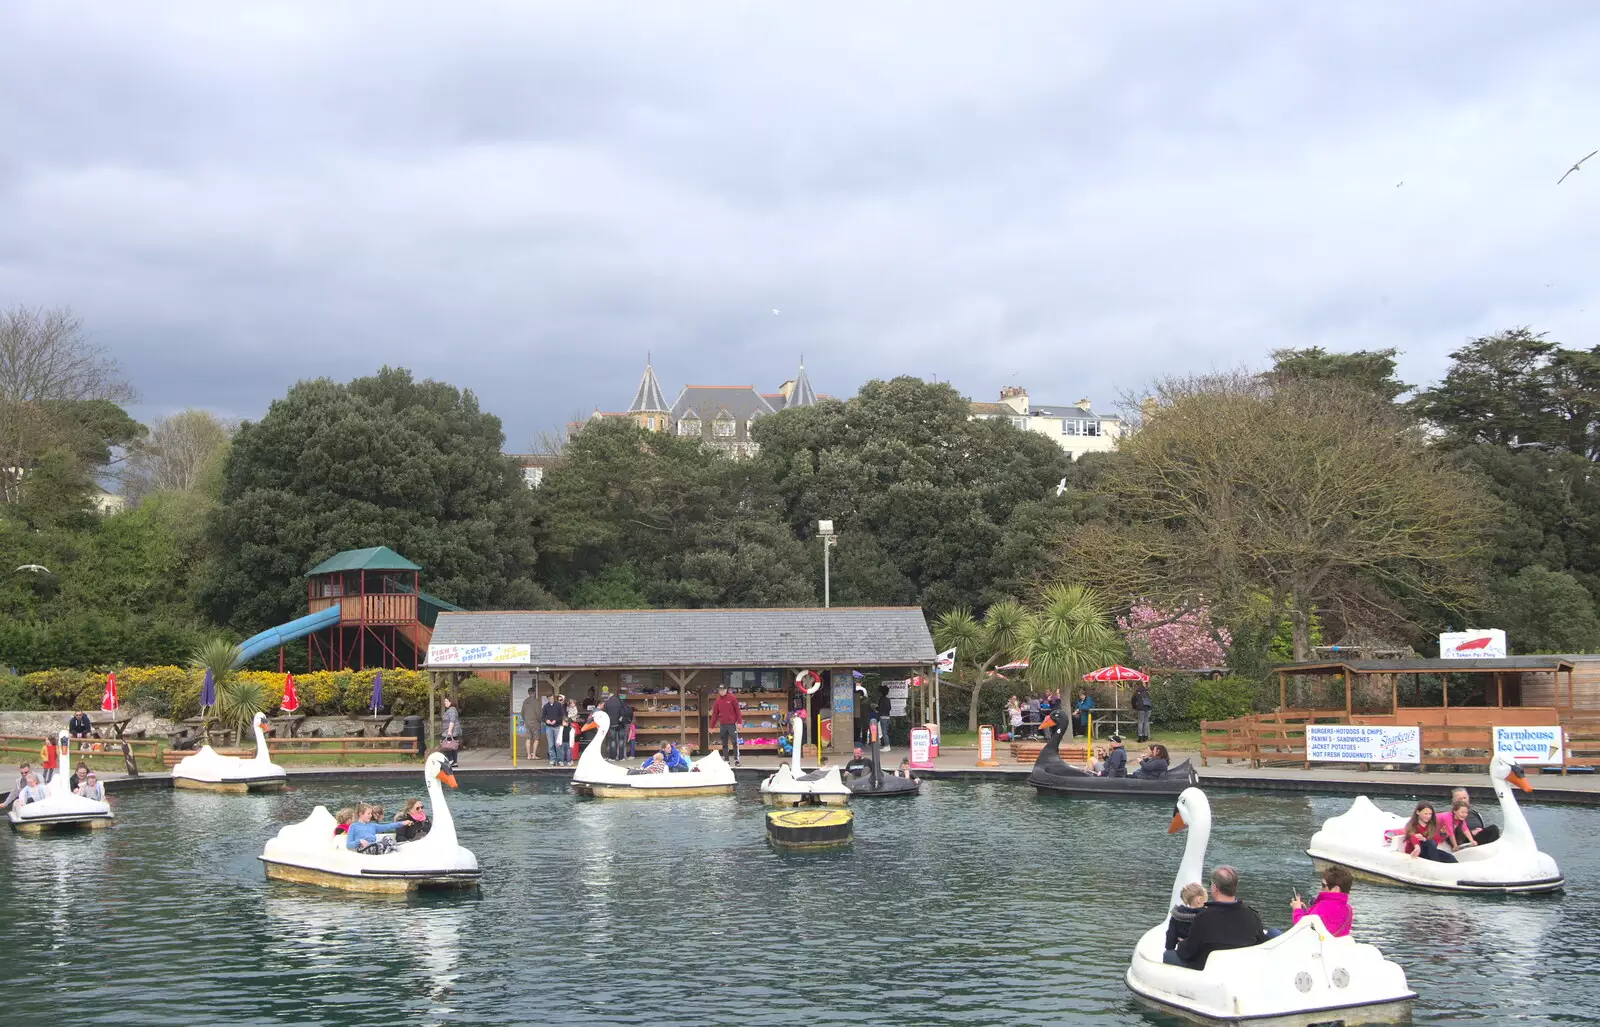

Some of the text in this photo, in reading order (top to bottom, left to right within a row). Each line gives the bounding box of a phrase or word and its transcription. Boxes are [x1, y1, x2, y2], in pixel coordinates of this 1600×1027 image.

[432, 648, 450, 656] FISH
[465, 646, 487, 654] COLD
[434, 653, 458, 662] CHIPS
[462, 651, 492, 662] DRINKS
[493, 650, 528, 662] CREAMS
[1497, 729, 1554, 740] Farmhouse
[1498, 741, 1547, 752] Ice Cream
